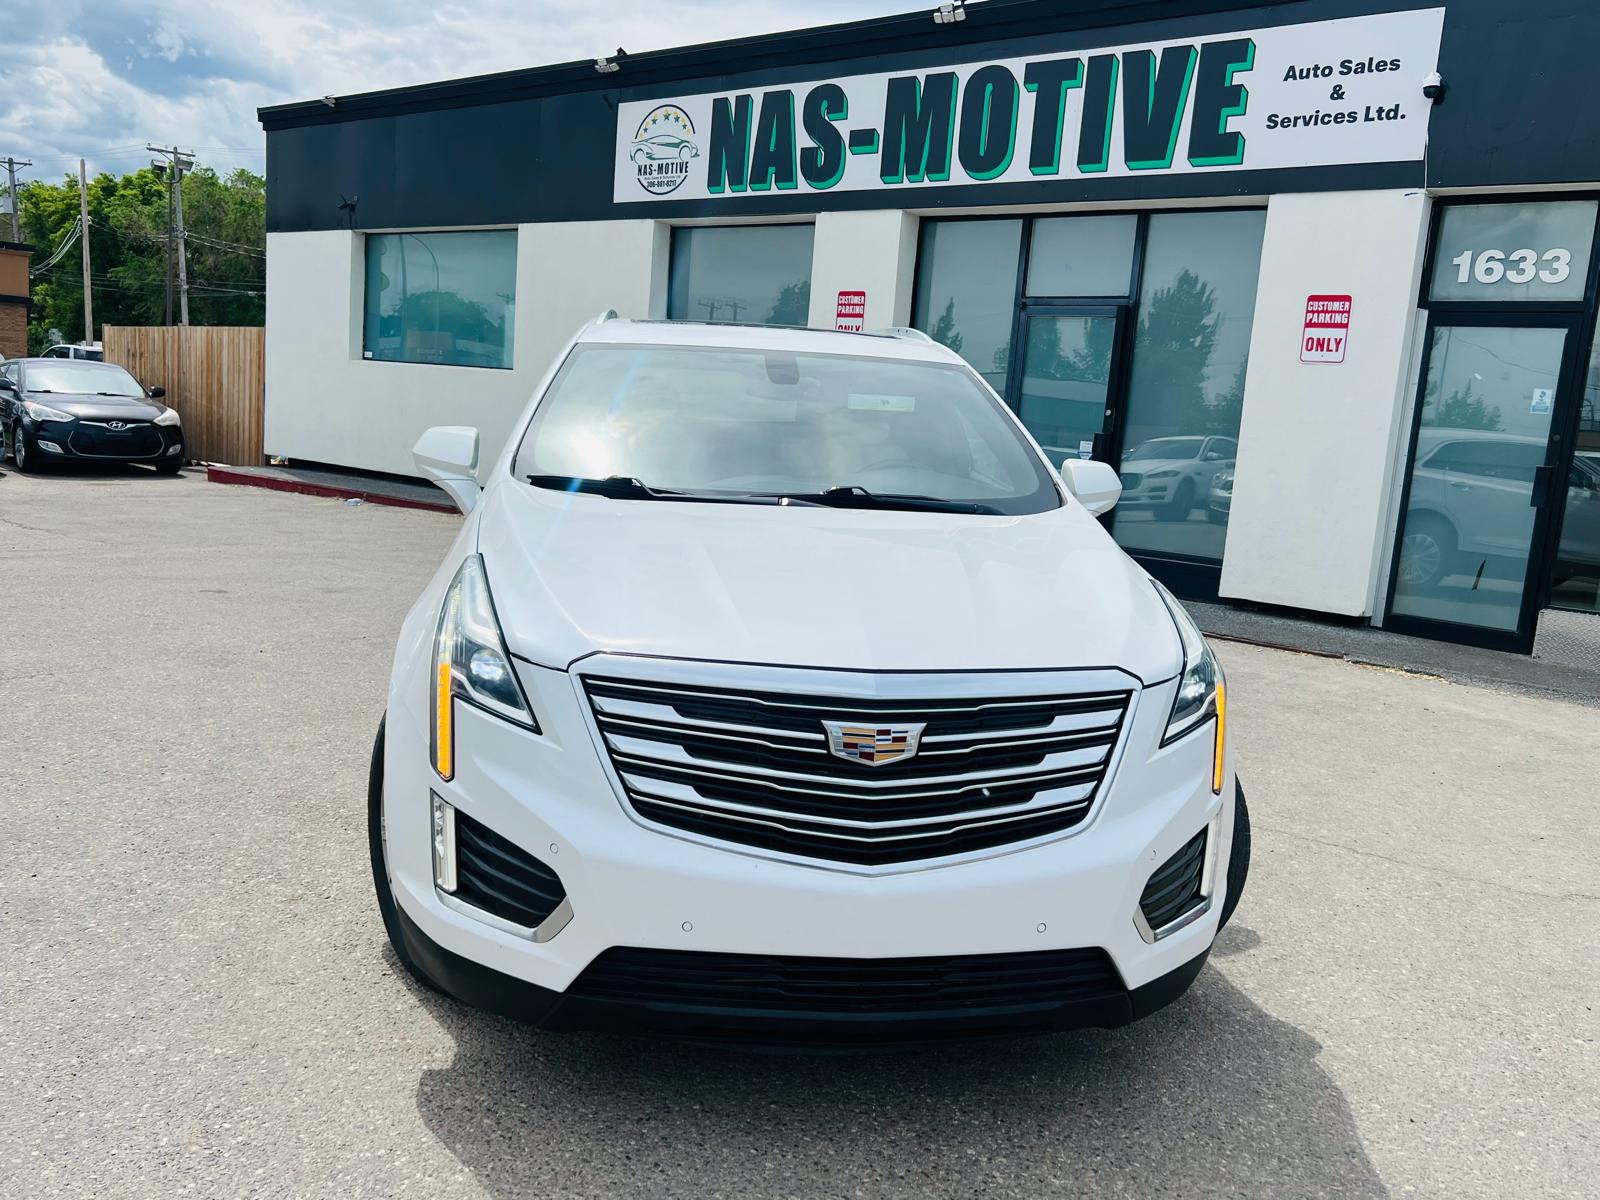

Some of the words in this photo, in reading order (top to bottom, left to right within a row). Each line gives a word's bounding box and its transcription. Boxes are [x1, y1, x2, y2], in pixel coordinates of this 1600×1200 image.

[1283, 64, 1333, 82] Auto
[1339, 57, 1401, 76] Sales
[1329, 84, 1346, 101] &
[707, 38, 1256, 194] NAS-MOTIVE
[1266, 110, 1358, 130] Services
[1364, 104, 1407, 122] Ltd.
[637, 161, 689, 176] NAS-MOTIVE
[1453, 248, 1571, 284] 1633
[837, 305, 864, 314] PARKING
[1307, 301, 1350, 311] CUSTOMER
[1306, 312, 1349, 324] PARKING
[1305, 337, 1343, 352] ONLY
